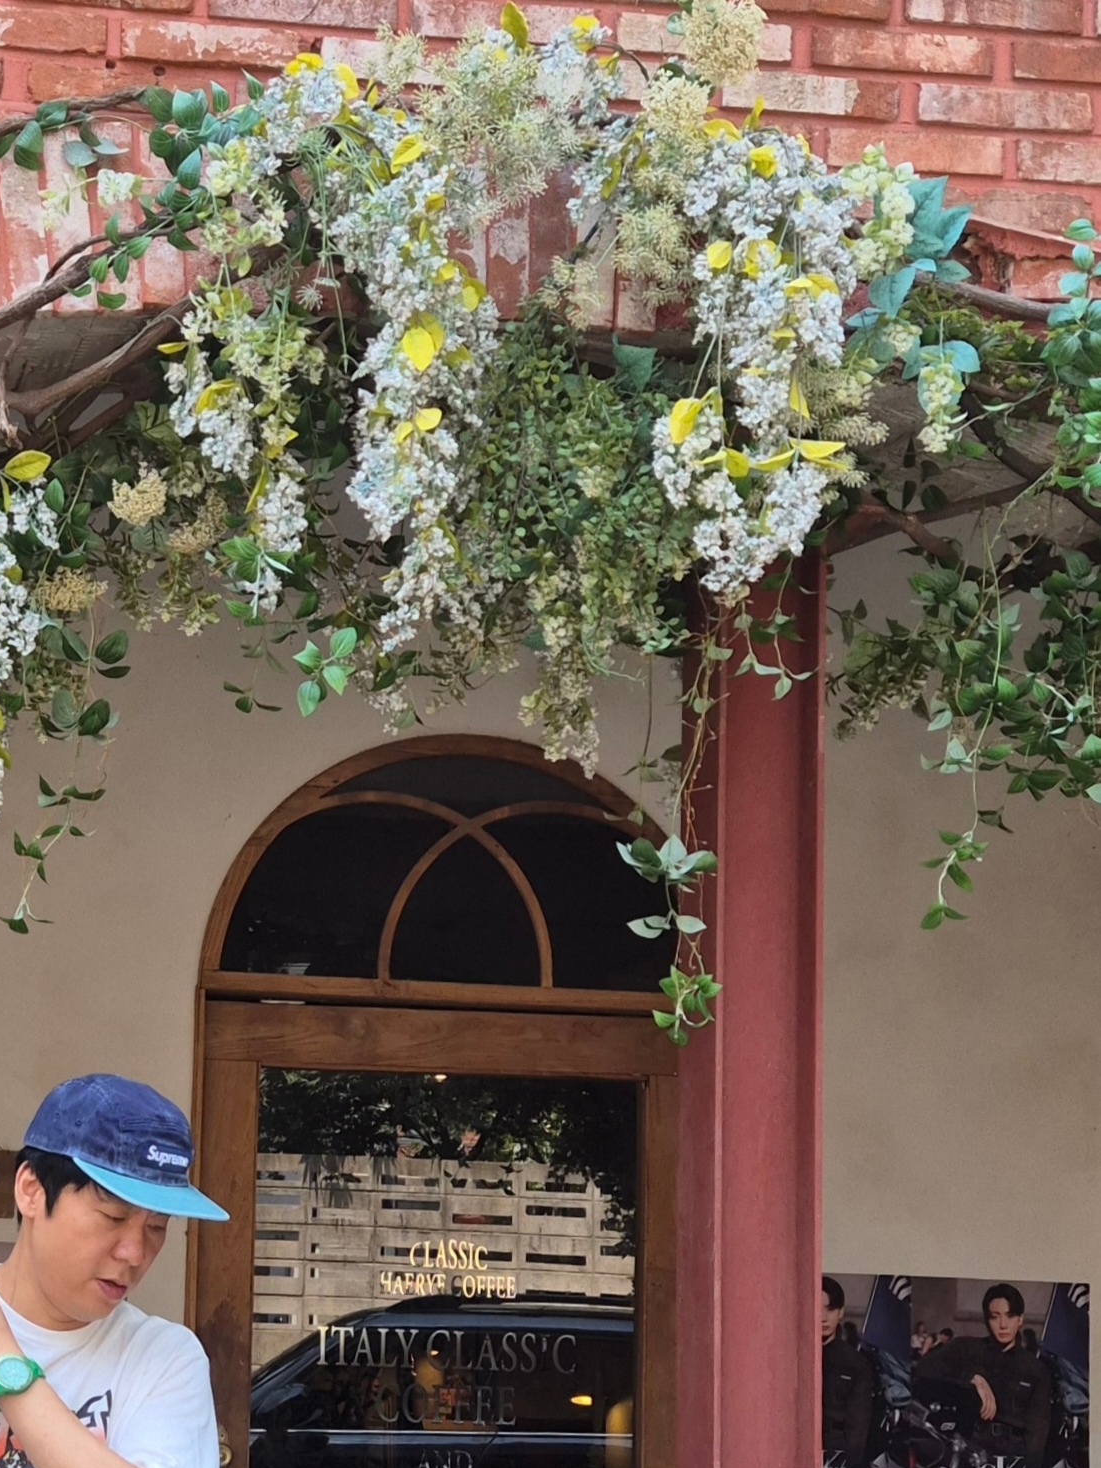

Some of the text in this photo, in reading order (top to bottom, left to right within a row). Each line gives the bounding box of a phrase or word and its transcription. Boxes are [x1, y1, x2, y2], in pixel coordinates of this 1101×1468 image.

[146, 1144, 189, 1168] Supreme
[409, 1238, 489, 1271] CLASSIC
[450, 1274, 517, 1299] COFFEE
[316, 1325, 577, 1375] ITALY CLASSIC
[374, 1382, 517, 1427] COFFEE
